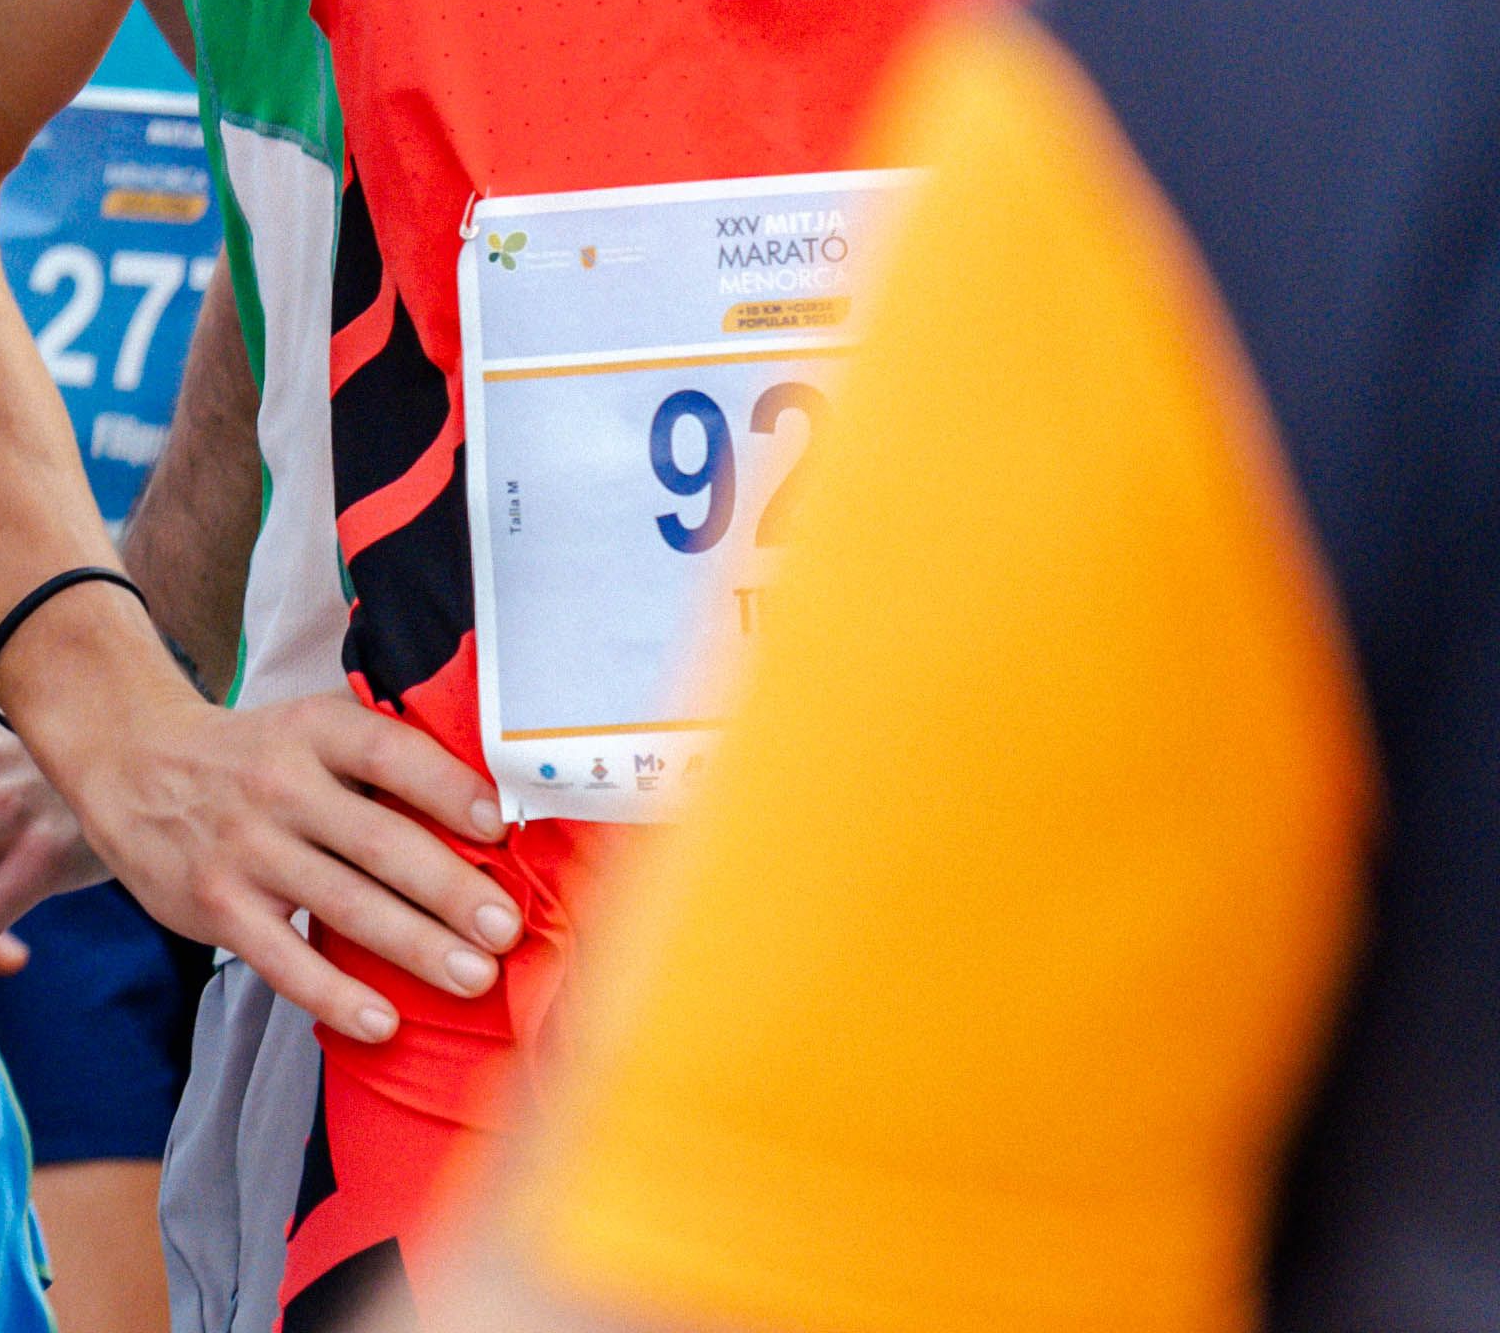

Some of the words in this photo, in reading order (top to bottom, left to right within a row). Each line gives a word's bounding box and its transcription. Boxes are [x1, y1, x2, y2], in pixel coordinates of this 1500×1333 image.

[716, 215, 761, 238] XXV
[764, 209, 845, 235] MITJA
[717, 228, 848, 270] MARATÓ
